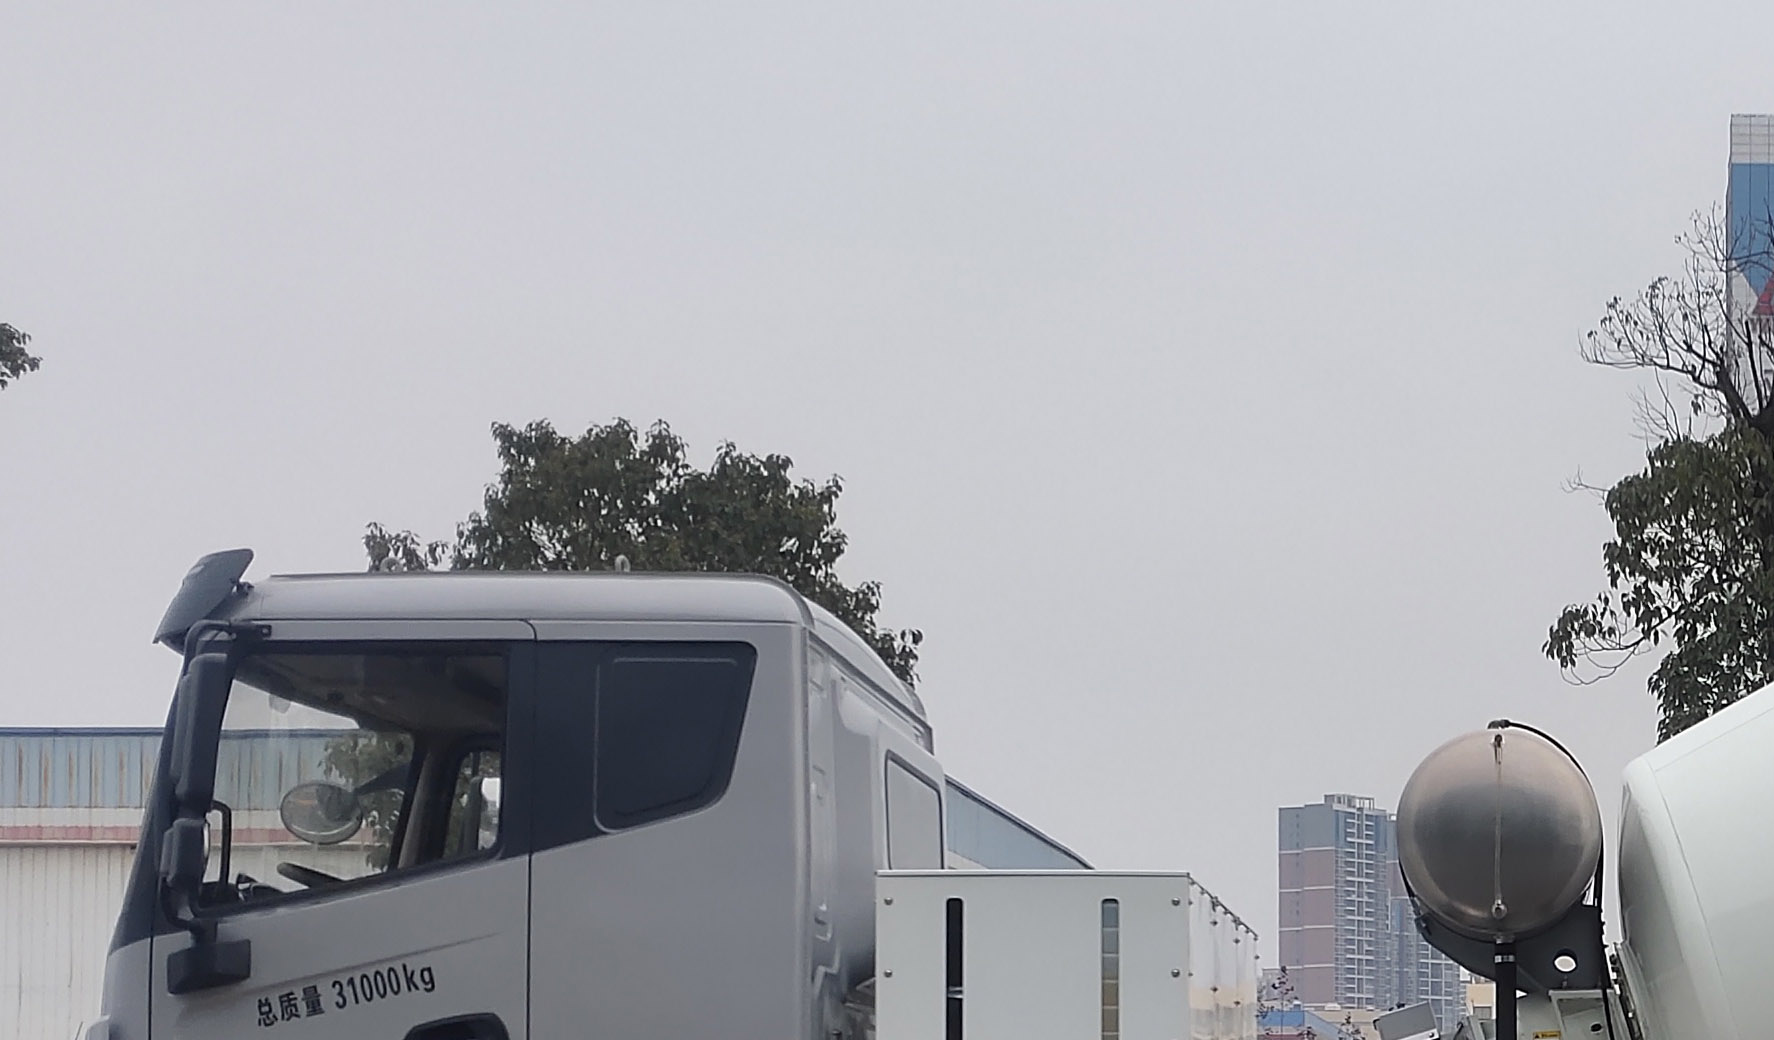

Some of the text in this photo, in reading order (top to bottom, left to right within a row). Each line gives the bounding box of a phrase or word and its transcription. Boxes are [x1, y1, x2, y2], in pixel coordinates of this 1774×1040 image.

[257, 963, 436, 1028] 总质量 31000kg
